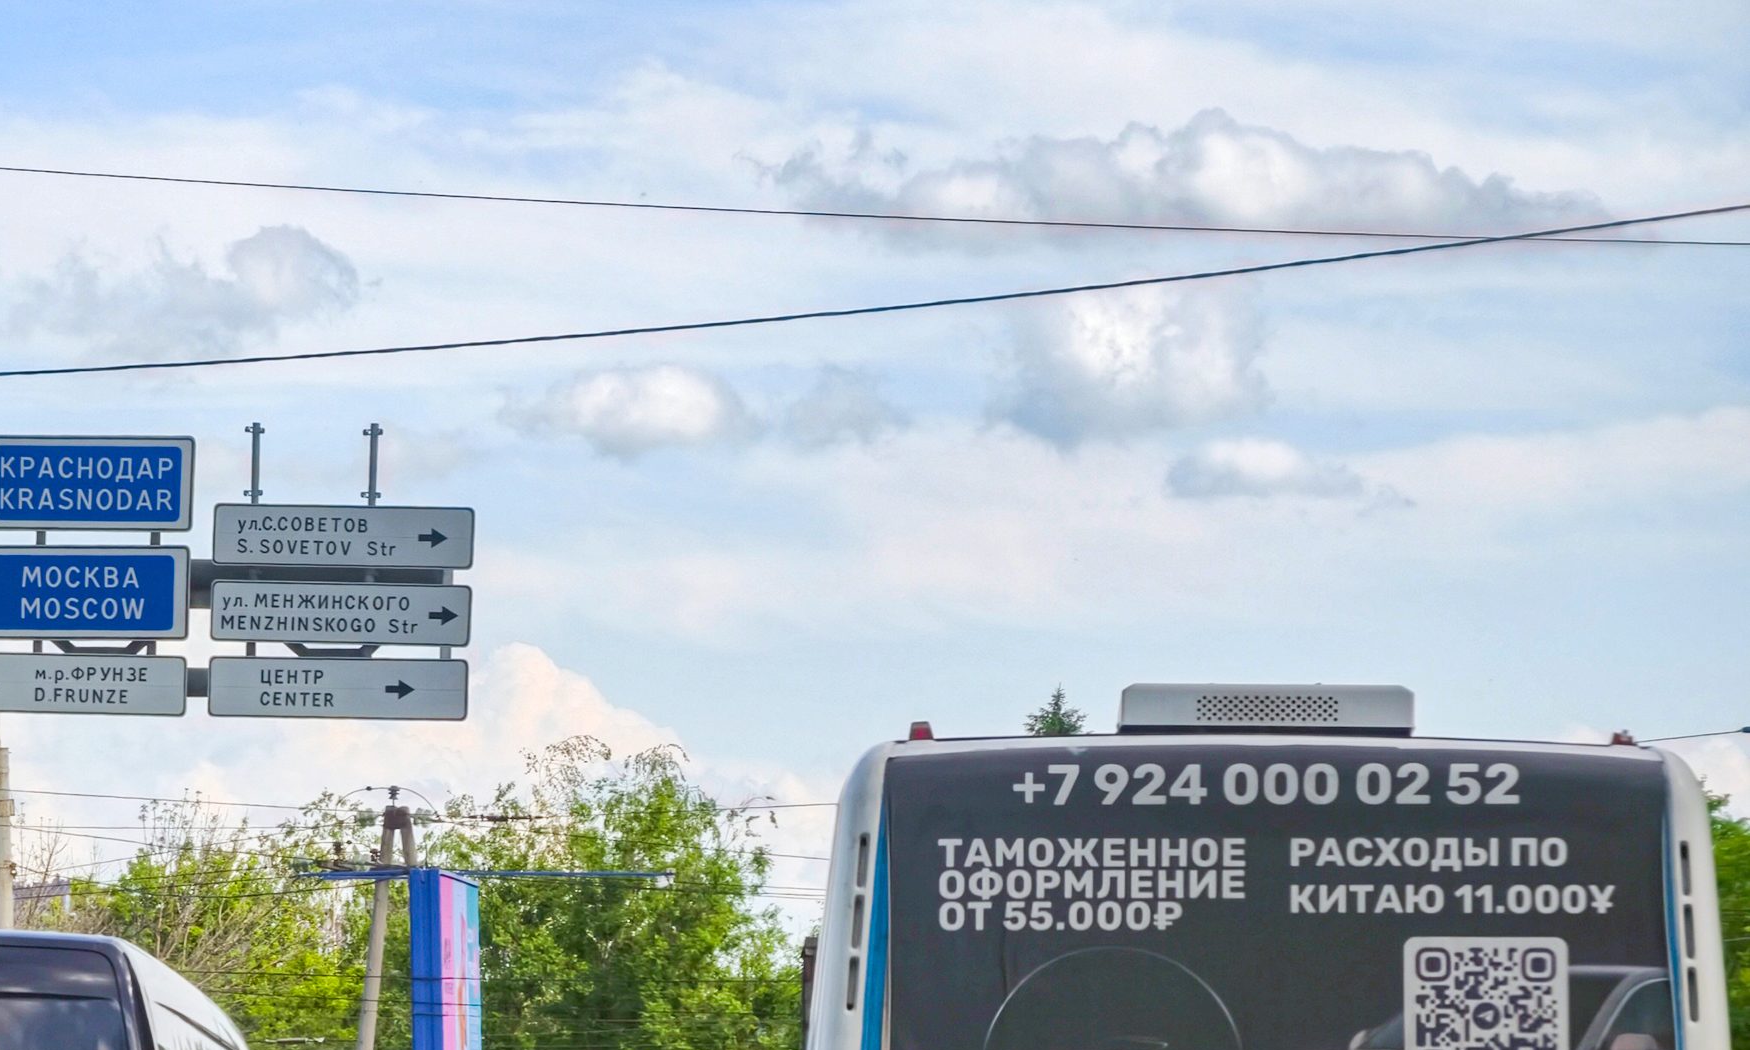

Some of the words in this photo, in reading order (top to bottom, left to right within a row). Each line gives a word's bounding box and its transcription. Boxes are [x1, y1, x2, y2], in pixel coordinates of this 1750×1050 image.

[0, 456, 174, 483] КРАСНОДАР
[0, 488, 173, 511] KRASNODAR
[366, 541, 396, 556] Str
[21, 566, 139, 589] МОСКВА
[20, 597, 145, 620] MOSCOW
[221, 615, 376, 633] MENZHINSKOGO
[388, 618, 418, 634] Str
[260, 669, 324, 686] ЦЕНТР
[260, 691, 334, 707] CENTER
[1012, 765, 1080, 805] +7
[1093, 764, 1207, 805] 924
[1222, 764, 1346, 805] 000
[1355, 764, 1430, 805] 02
[1445, 764, 1520, 805] 52
[938, 838, 1247, 868] ТАМОЖЕННОЕ
[1290, 838, 1499, 871] РАСХОДЫ
[1510, 838, 1568, 867] ПО
[938, 869, 1247, 899] ОФОРМЛЕНИЕ
[1290, 885, 1445, 914] КИТАЮ
[938, 902, 994, 931] ОТ
